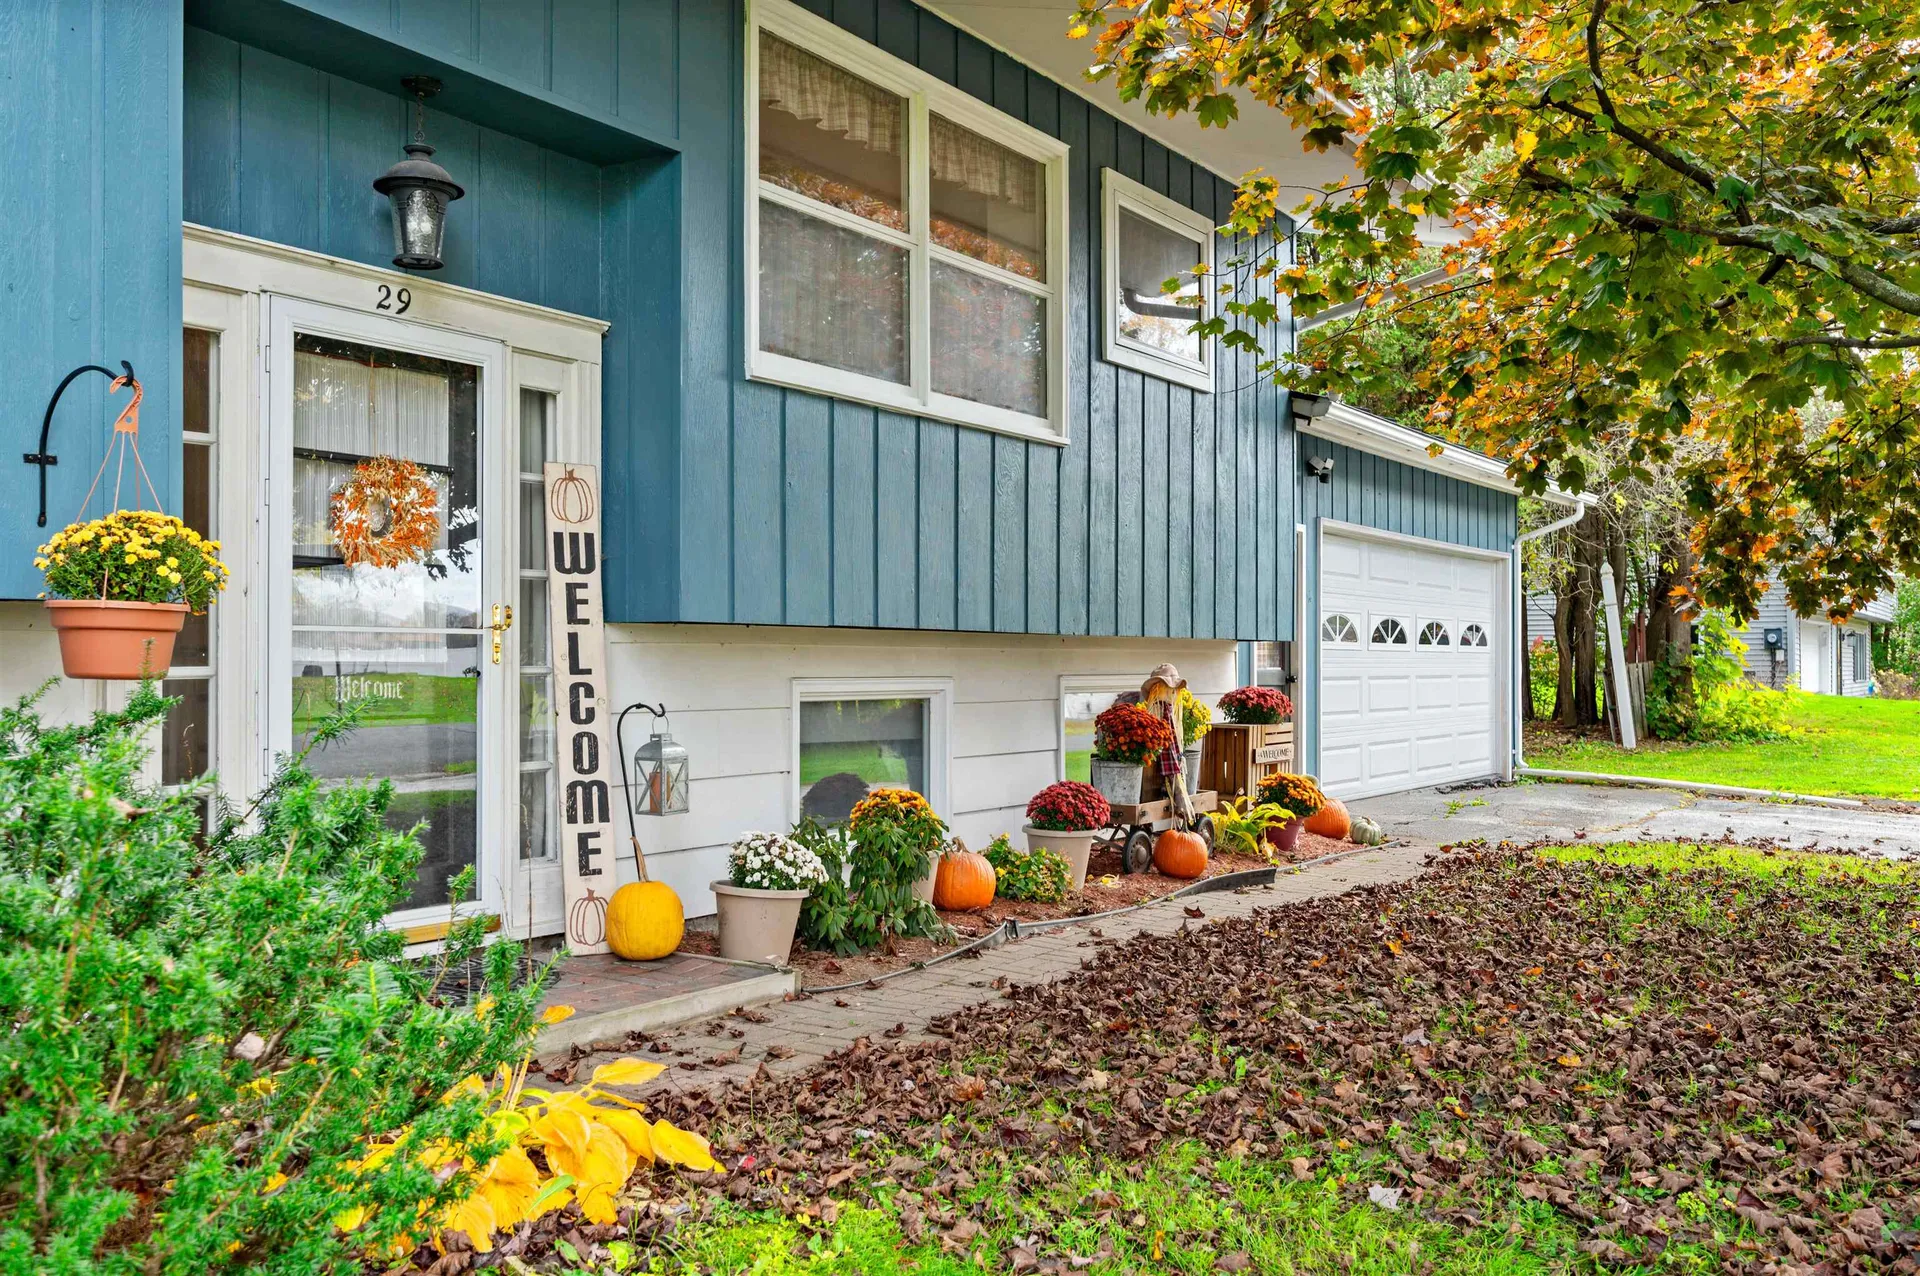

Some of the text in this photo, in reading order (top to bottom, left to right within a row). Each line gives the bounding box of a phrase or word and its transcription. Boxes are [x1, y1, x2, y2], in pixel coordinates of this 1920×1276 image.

[376, 284, 411, 314] 29
[335, 675, 404, 703] Welcome
[553, 531, 610, 877] WELCOME
[1262, 748, 1290, 759] WELCOME
